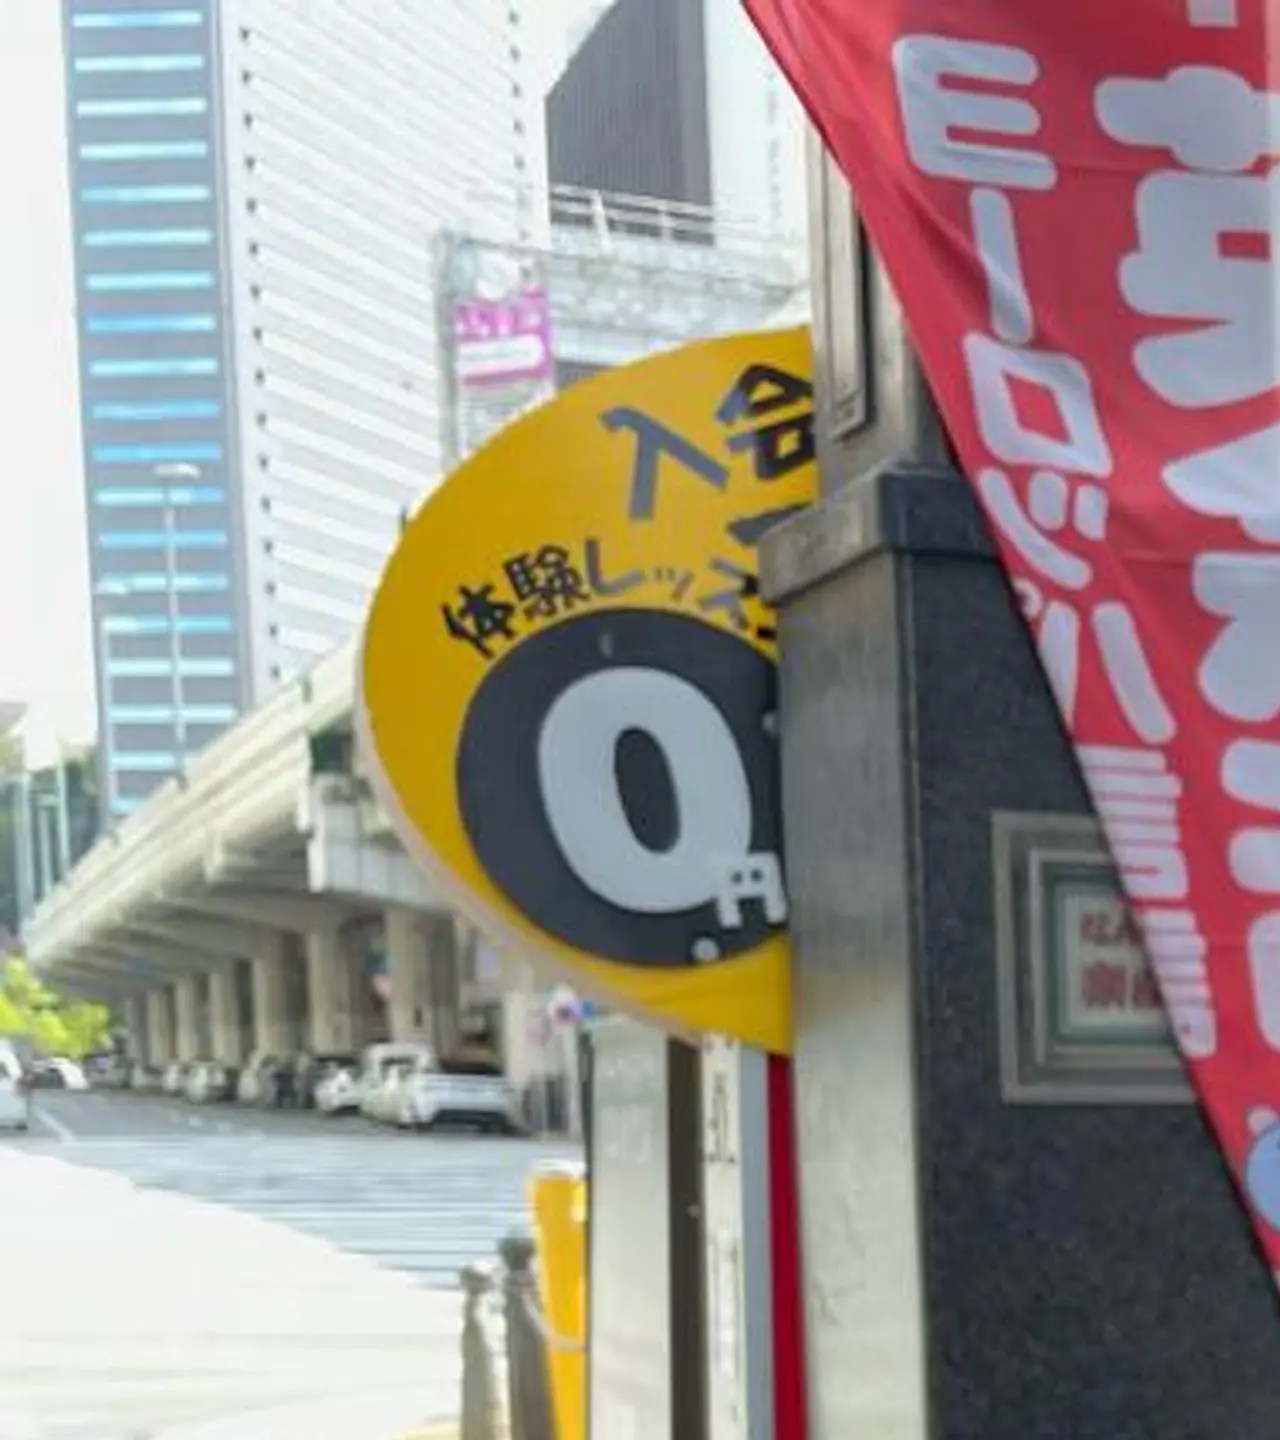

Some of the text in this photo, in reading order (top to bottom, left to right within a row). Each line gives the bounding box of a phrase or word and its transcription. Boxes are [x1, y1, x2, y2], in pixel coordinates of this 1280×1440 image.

[440, 537, 778, 661] 体験レッス
